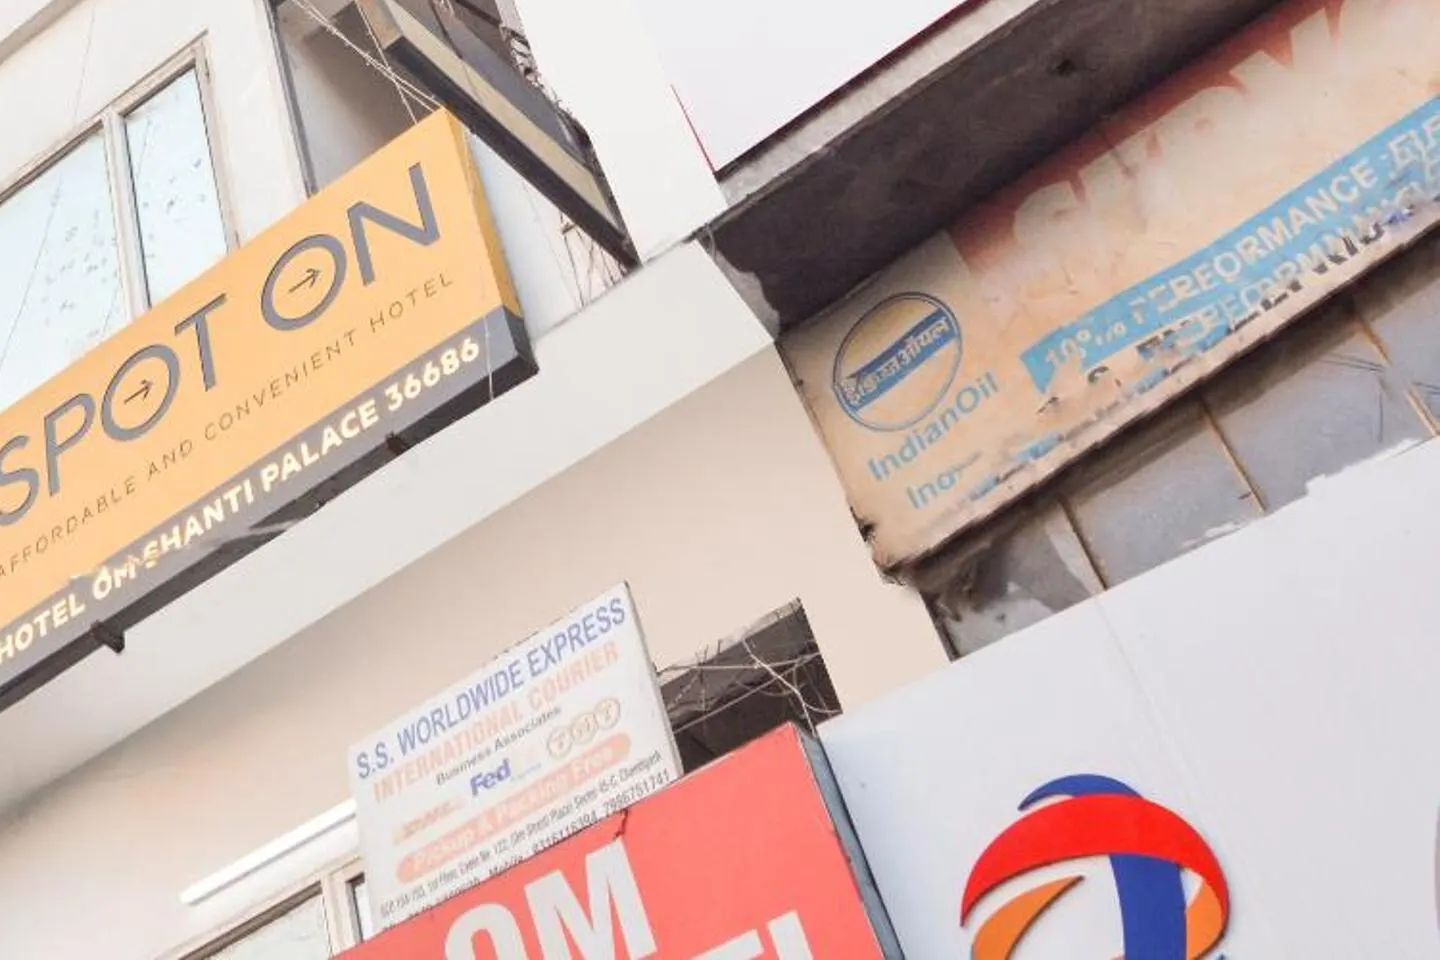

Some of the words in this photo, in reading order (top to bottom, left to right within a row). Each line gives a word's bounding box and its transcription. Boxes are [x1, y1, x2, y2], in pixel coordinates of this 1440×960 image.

[260, 162, 441, 331] ON
[147, 439, 194, 480] AND
[204, 329, 358, 442] CONVENIENT
[369, 273, 454, 334] HOTEL
[867, 371, 998, 481] IndianOil
[92, 564, 138, 601] OM
[142, 480, 254, 570] SHANTI
[260, 400, 381, 492] PALACE
[384, 338, 480, 413] 36686
[357, 741, 395, 780] S.S.
[397, 659, 525, 757] WORLDWIDE
[527, 598, 626, 678] EXPRESS
[374, 701, 523, 803] INTERNATIONAL
[527, 640, 620, 710] COURIER
[435, 746, 492, 785] Business
[494, 707, 561, 751] Associates
[445, 839, 658, 960] OM
